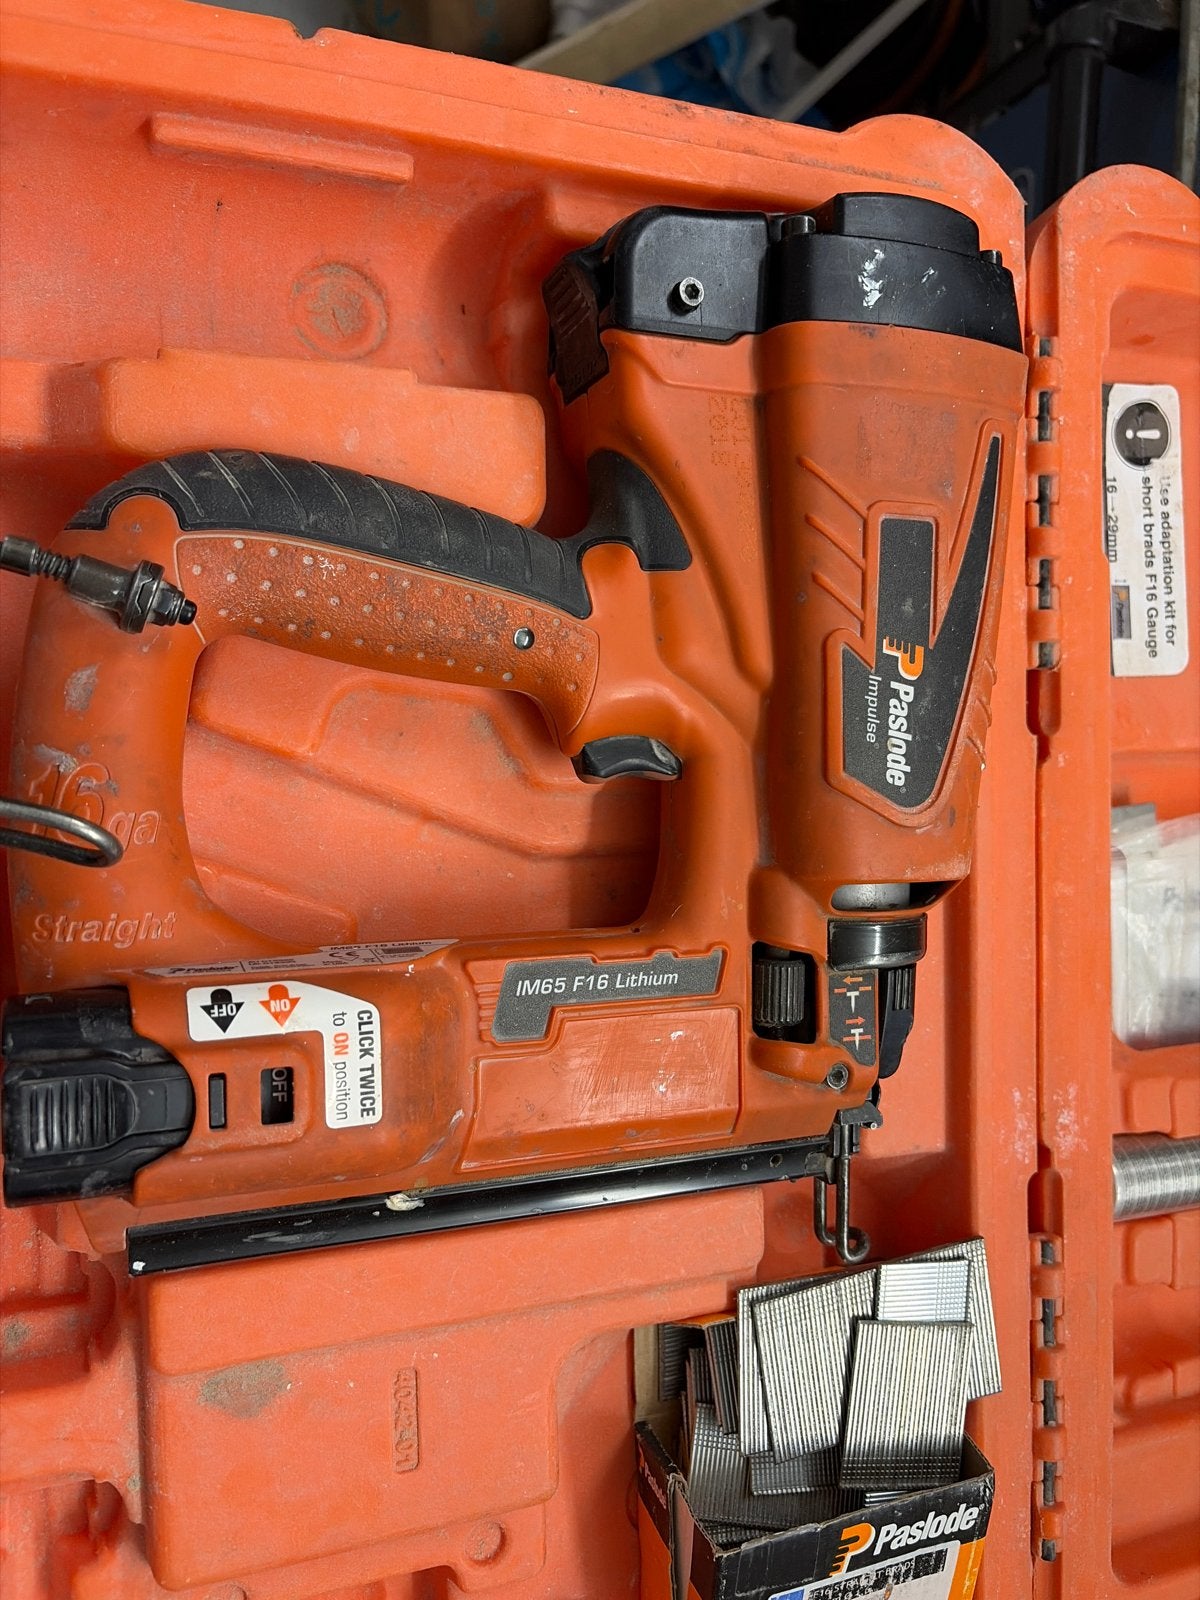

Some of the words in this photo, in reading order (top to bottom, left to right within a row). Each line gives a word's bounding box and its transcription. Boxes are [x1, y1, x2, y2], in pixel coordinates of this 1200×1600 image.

[1142, 476, 1153, 518] short
[1143, 523, 1155, 568] brads
[1159, 511, 1174, 595] adaptation
[1145, 574, 1157, 602] F16
[1164, 600, 1176, 619] kit
[1145, 607, 1158, 658] Gauge
[1165, 624, 1176, 646] for
[865, 674, 882, 743] Impulse
[886, 681, 914, 787] Paslode
[32, 912, 177, 949] Straight
[516, 977, 566, 996] IM65
[573, 974, 609, 992] F16
[615, 972, 678, 989] Lithium
[210, 1003, 237, 1018] OFF
[269, 999, 291, 1012] ON
[333, 1011, 347, 1027] to
[333, 1032, 349, 1056] ON
[357, 1009, 374, 1059] CLICK
[272, 1068, 287, 1103] OFF
[332, 1061, 351, 1120] position
[360, 1063, 376, 1118] TWICE
[873, 1503, 979, 1556] Paslode
